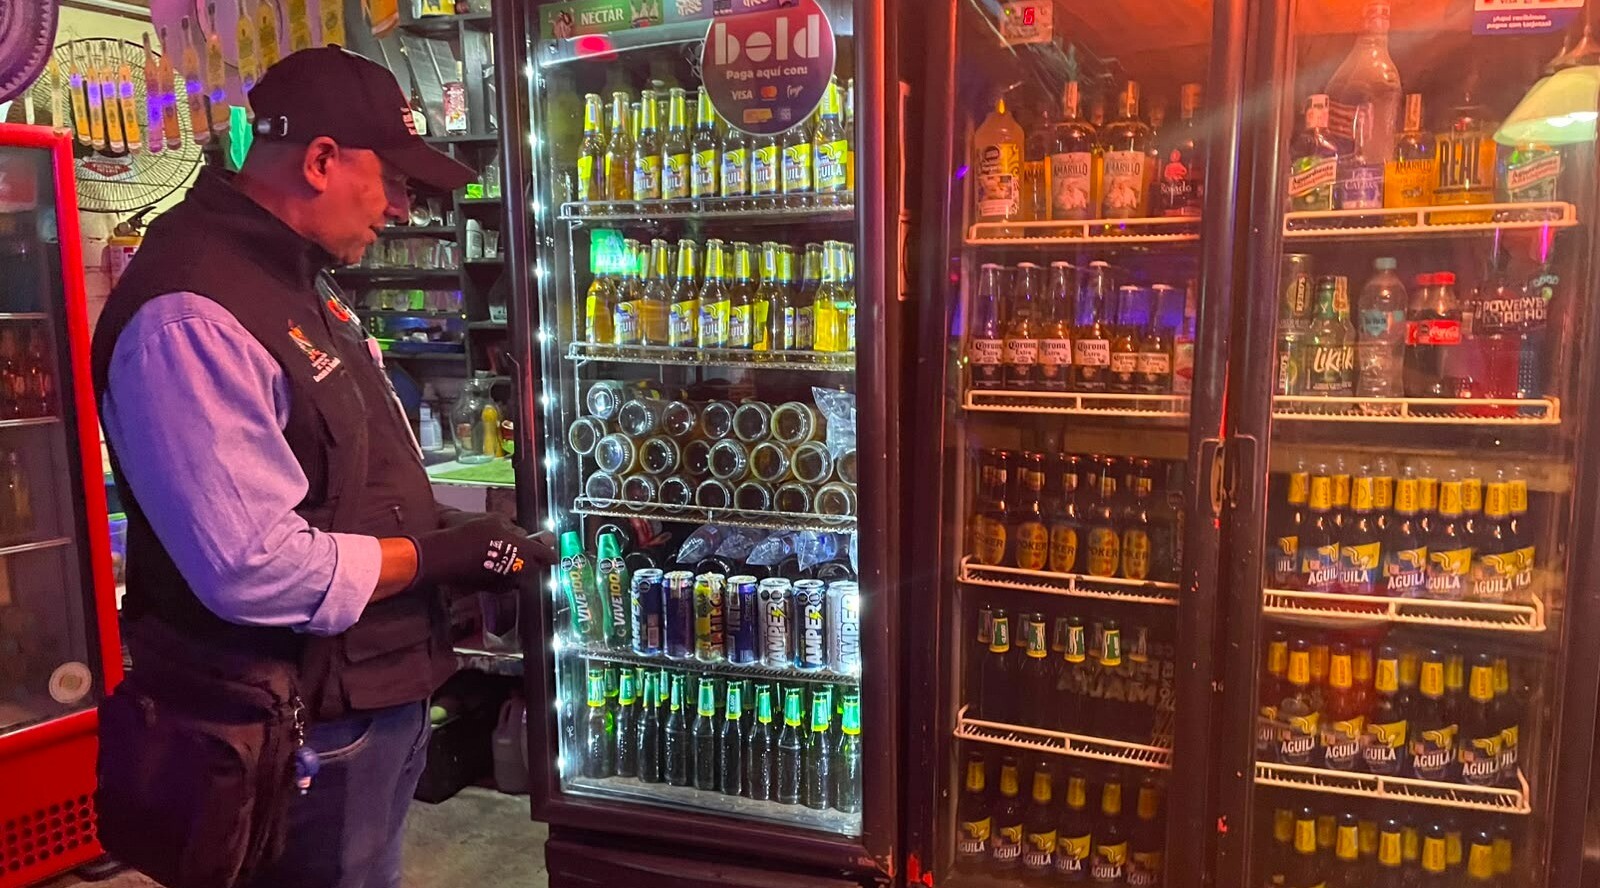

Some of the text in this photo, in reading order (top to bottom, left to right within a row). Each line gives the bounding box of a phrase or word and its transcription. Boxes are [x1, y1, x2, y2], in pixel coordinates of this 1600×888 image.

[580, 8, 624, 25] NECTAR
[714, 14, 820, 65] bold
[726, 66, 808, 80] Paga aquí con:
[731, 90, 754, 100] VISA
[1054, 162, 1088, 176] AMARILLO
[1105, 162, 1140, 175] AMARILLO
[1008, 340, 1036, 350] Corona
[1077, 341, 1106, 351] Corona
[609, 572, 627, 627] VIVE100
[766, 601, 786, 664] AMPER
[804, 602, 824, 666] AMPER
